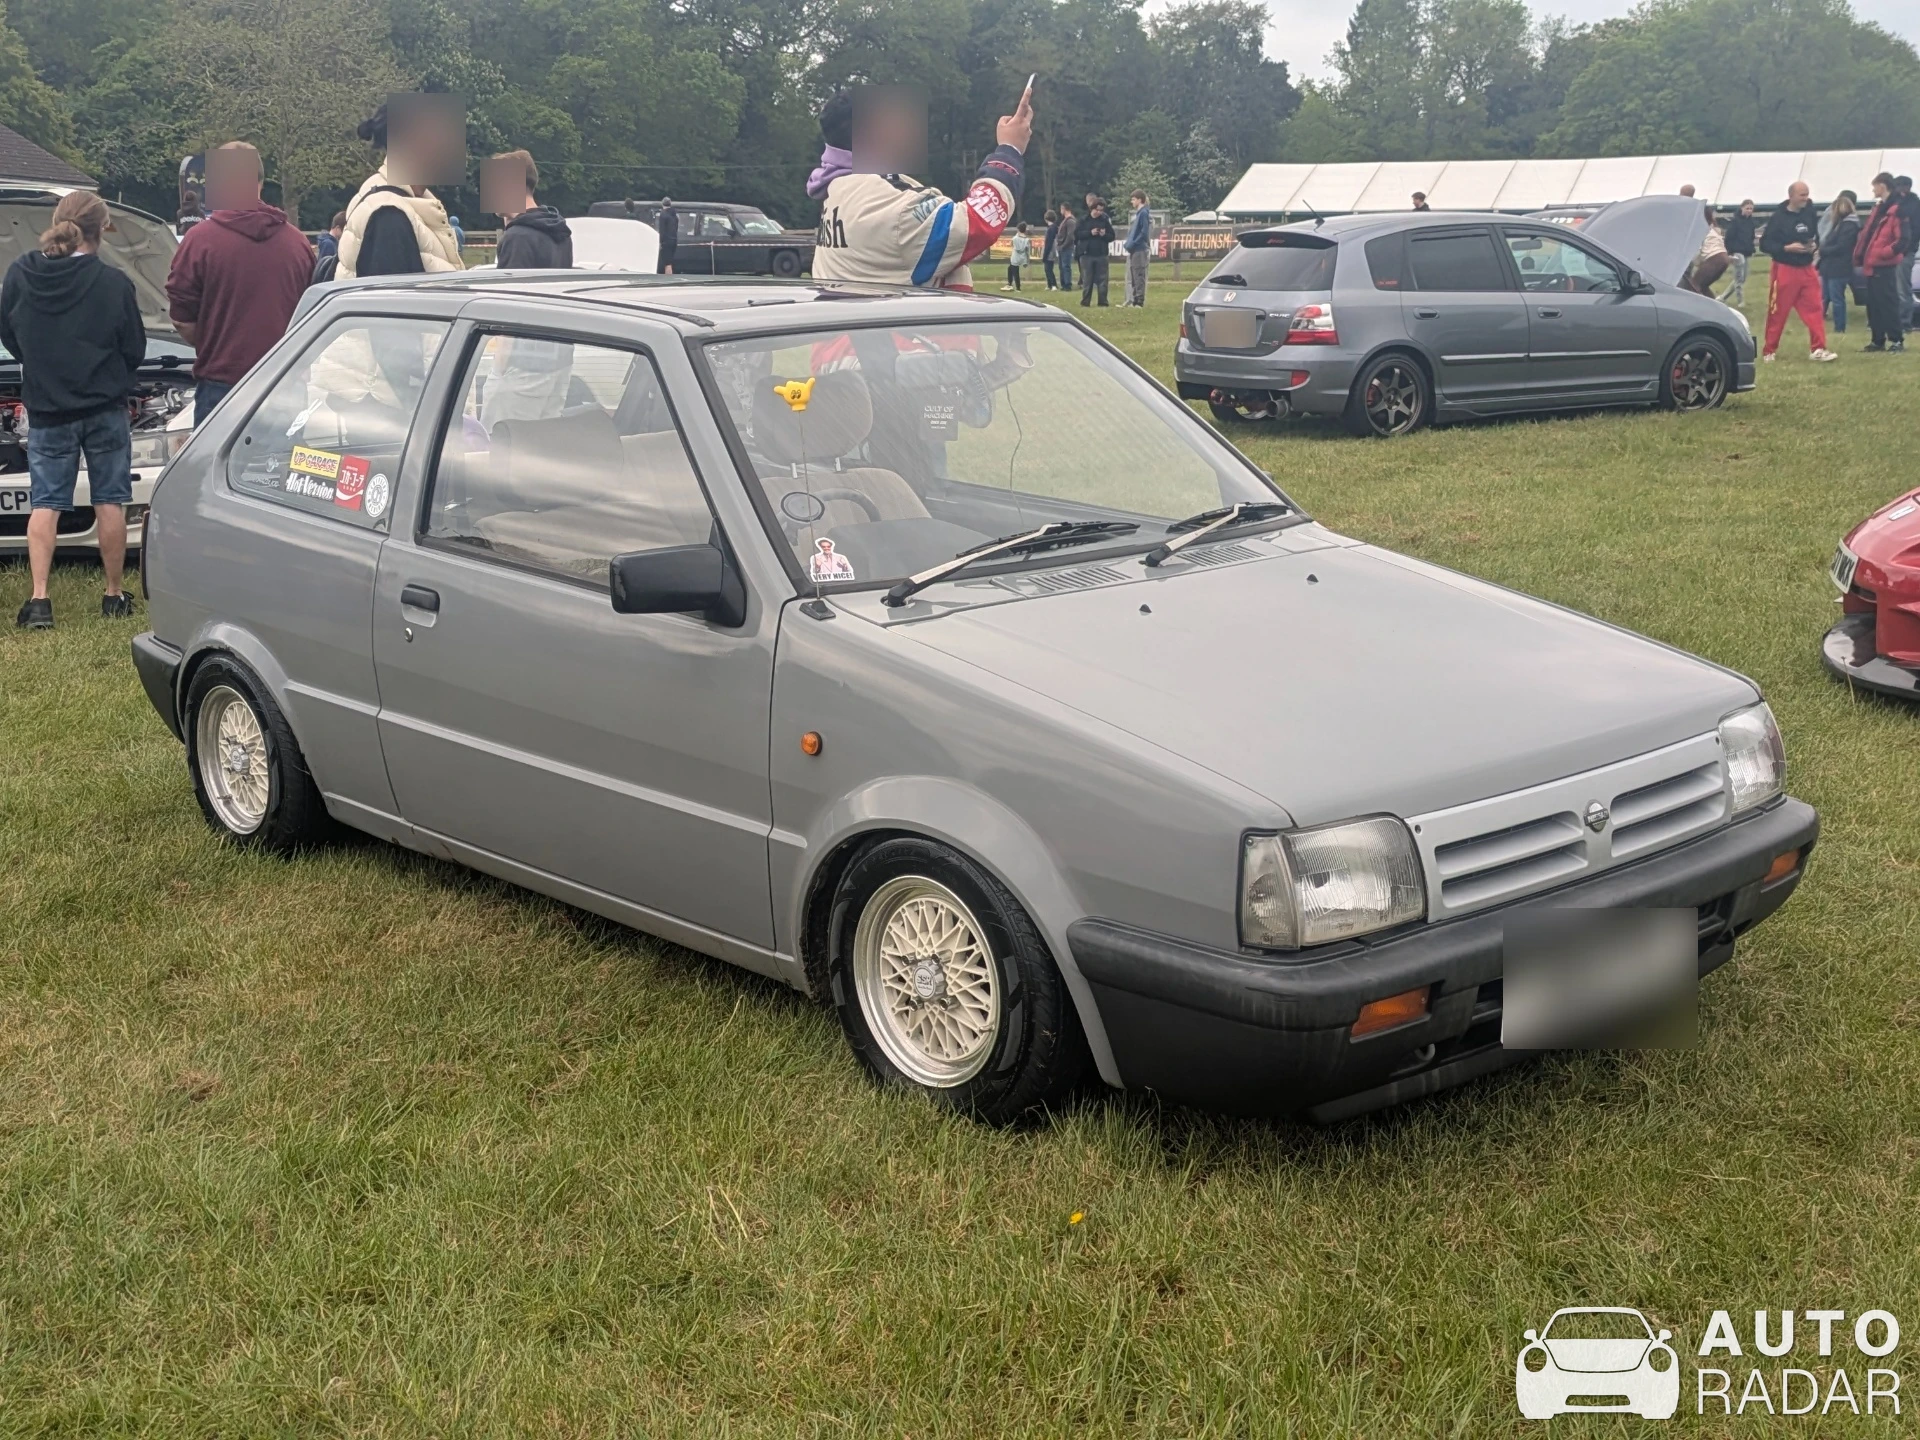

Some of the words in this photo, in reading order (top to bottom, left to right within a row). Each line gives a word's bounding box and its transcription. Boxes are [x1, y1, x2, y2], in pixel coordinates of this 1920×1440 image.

[294, 452, 306, 467] UP
[305, 454, 338, 473] GARAGE
[0, 490, 32, 511] CP
[812, 573, 831, 581] VERY
